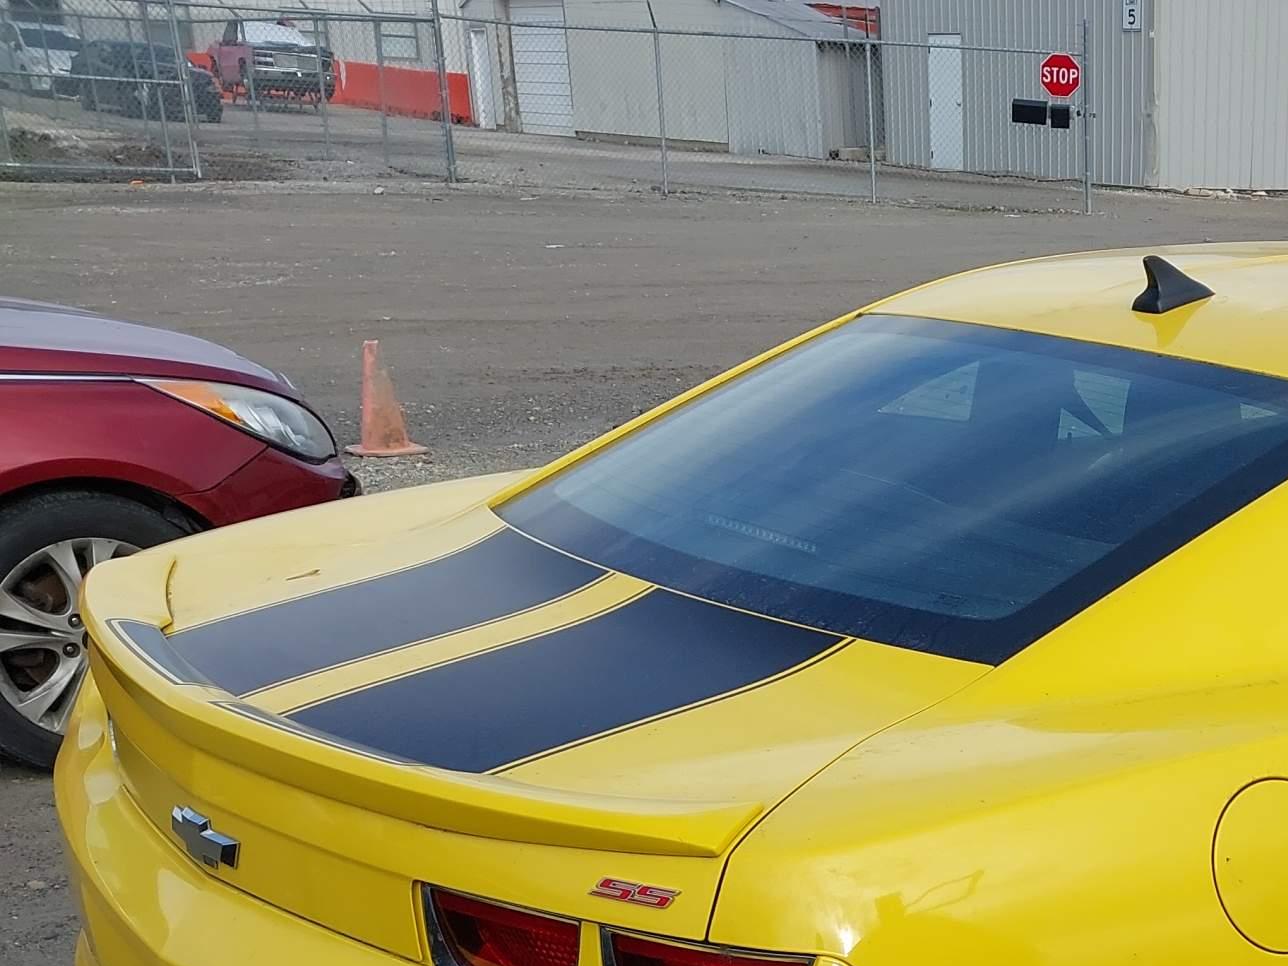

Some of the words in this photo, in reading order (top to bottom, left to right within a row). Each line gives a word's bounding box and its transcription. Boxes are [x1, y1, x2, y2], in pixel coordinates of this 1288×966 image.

[1128, 8, 1136, 25] 5
[1042, 66, 1079, 85] STOP
[588, 876, 681, 909] SS
